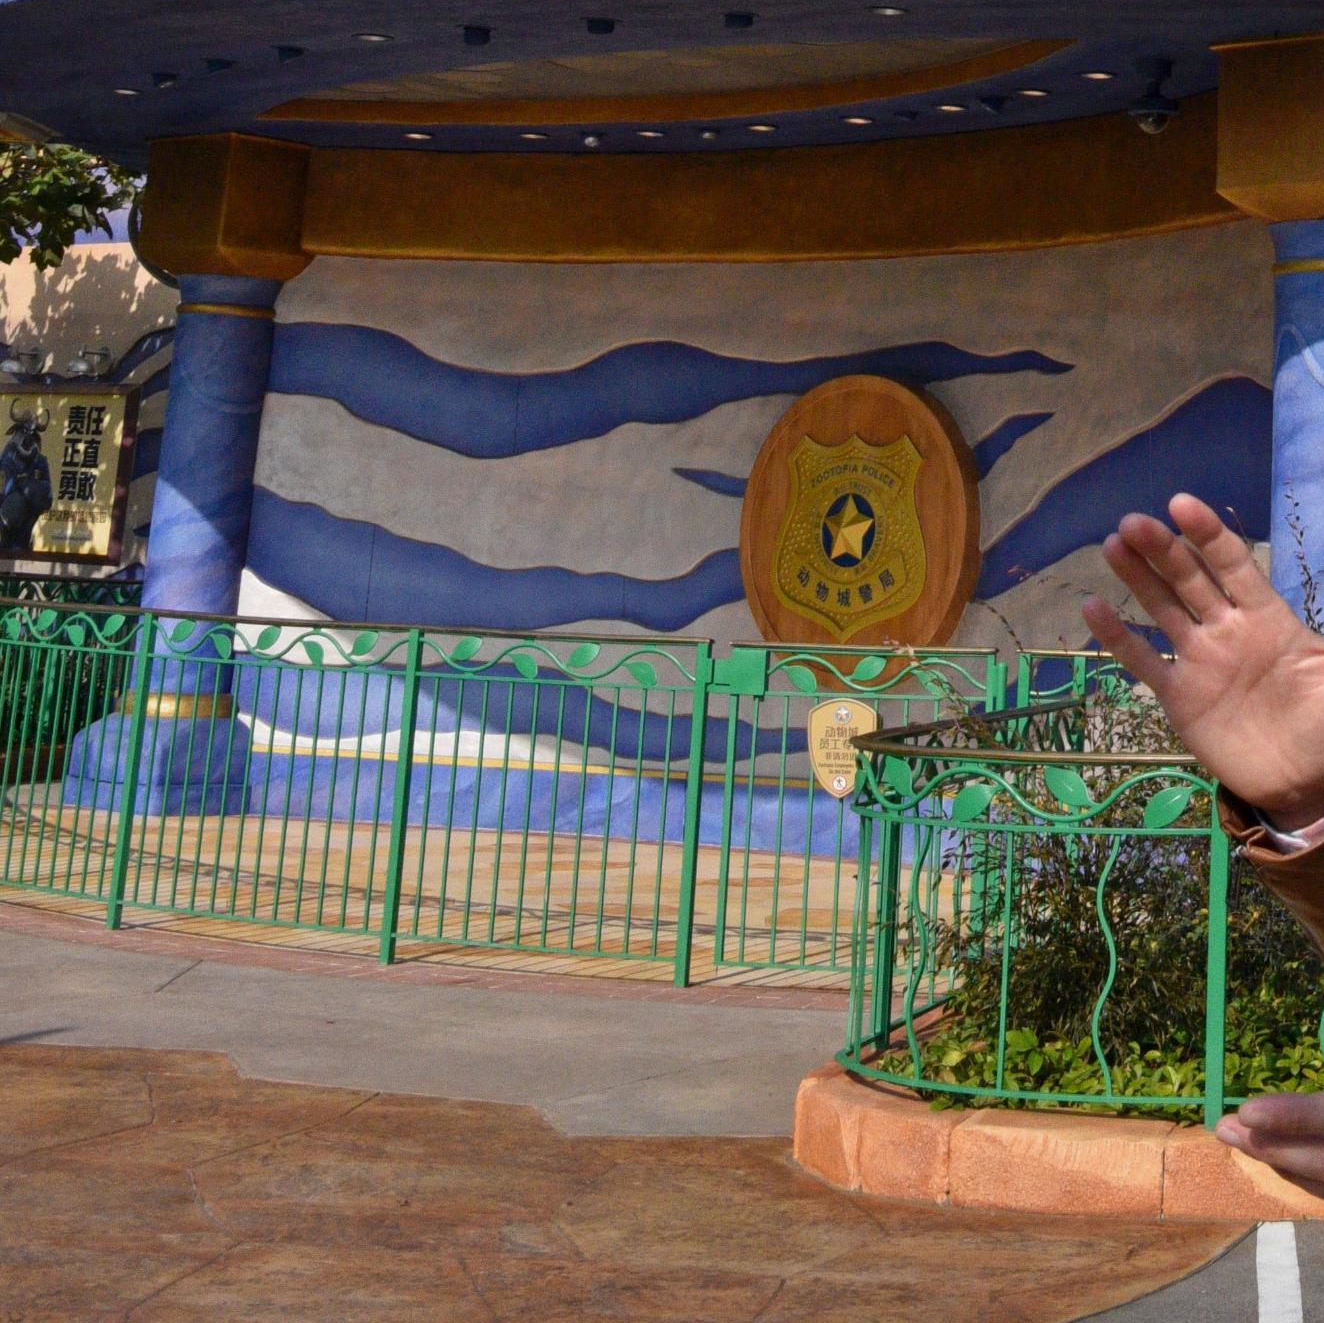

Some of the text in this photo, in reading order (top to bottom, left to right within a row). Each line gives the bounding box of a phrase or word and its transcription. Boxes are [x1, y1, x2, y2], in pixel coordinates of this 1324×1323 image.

[66, 405, 106, 435] 责任
[62, 438, 101, 468] 正直
[58, 470, 98, 501] 勇敢
[811, 464, 859, 488] ZOOTOPIA
[861, 464, 896, 489] POLICE
[819, 738, 853, 750] 员工专
